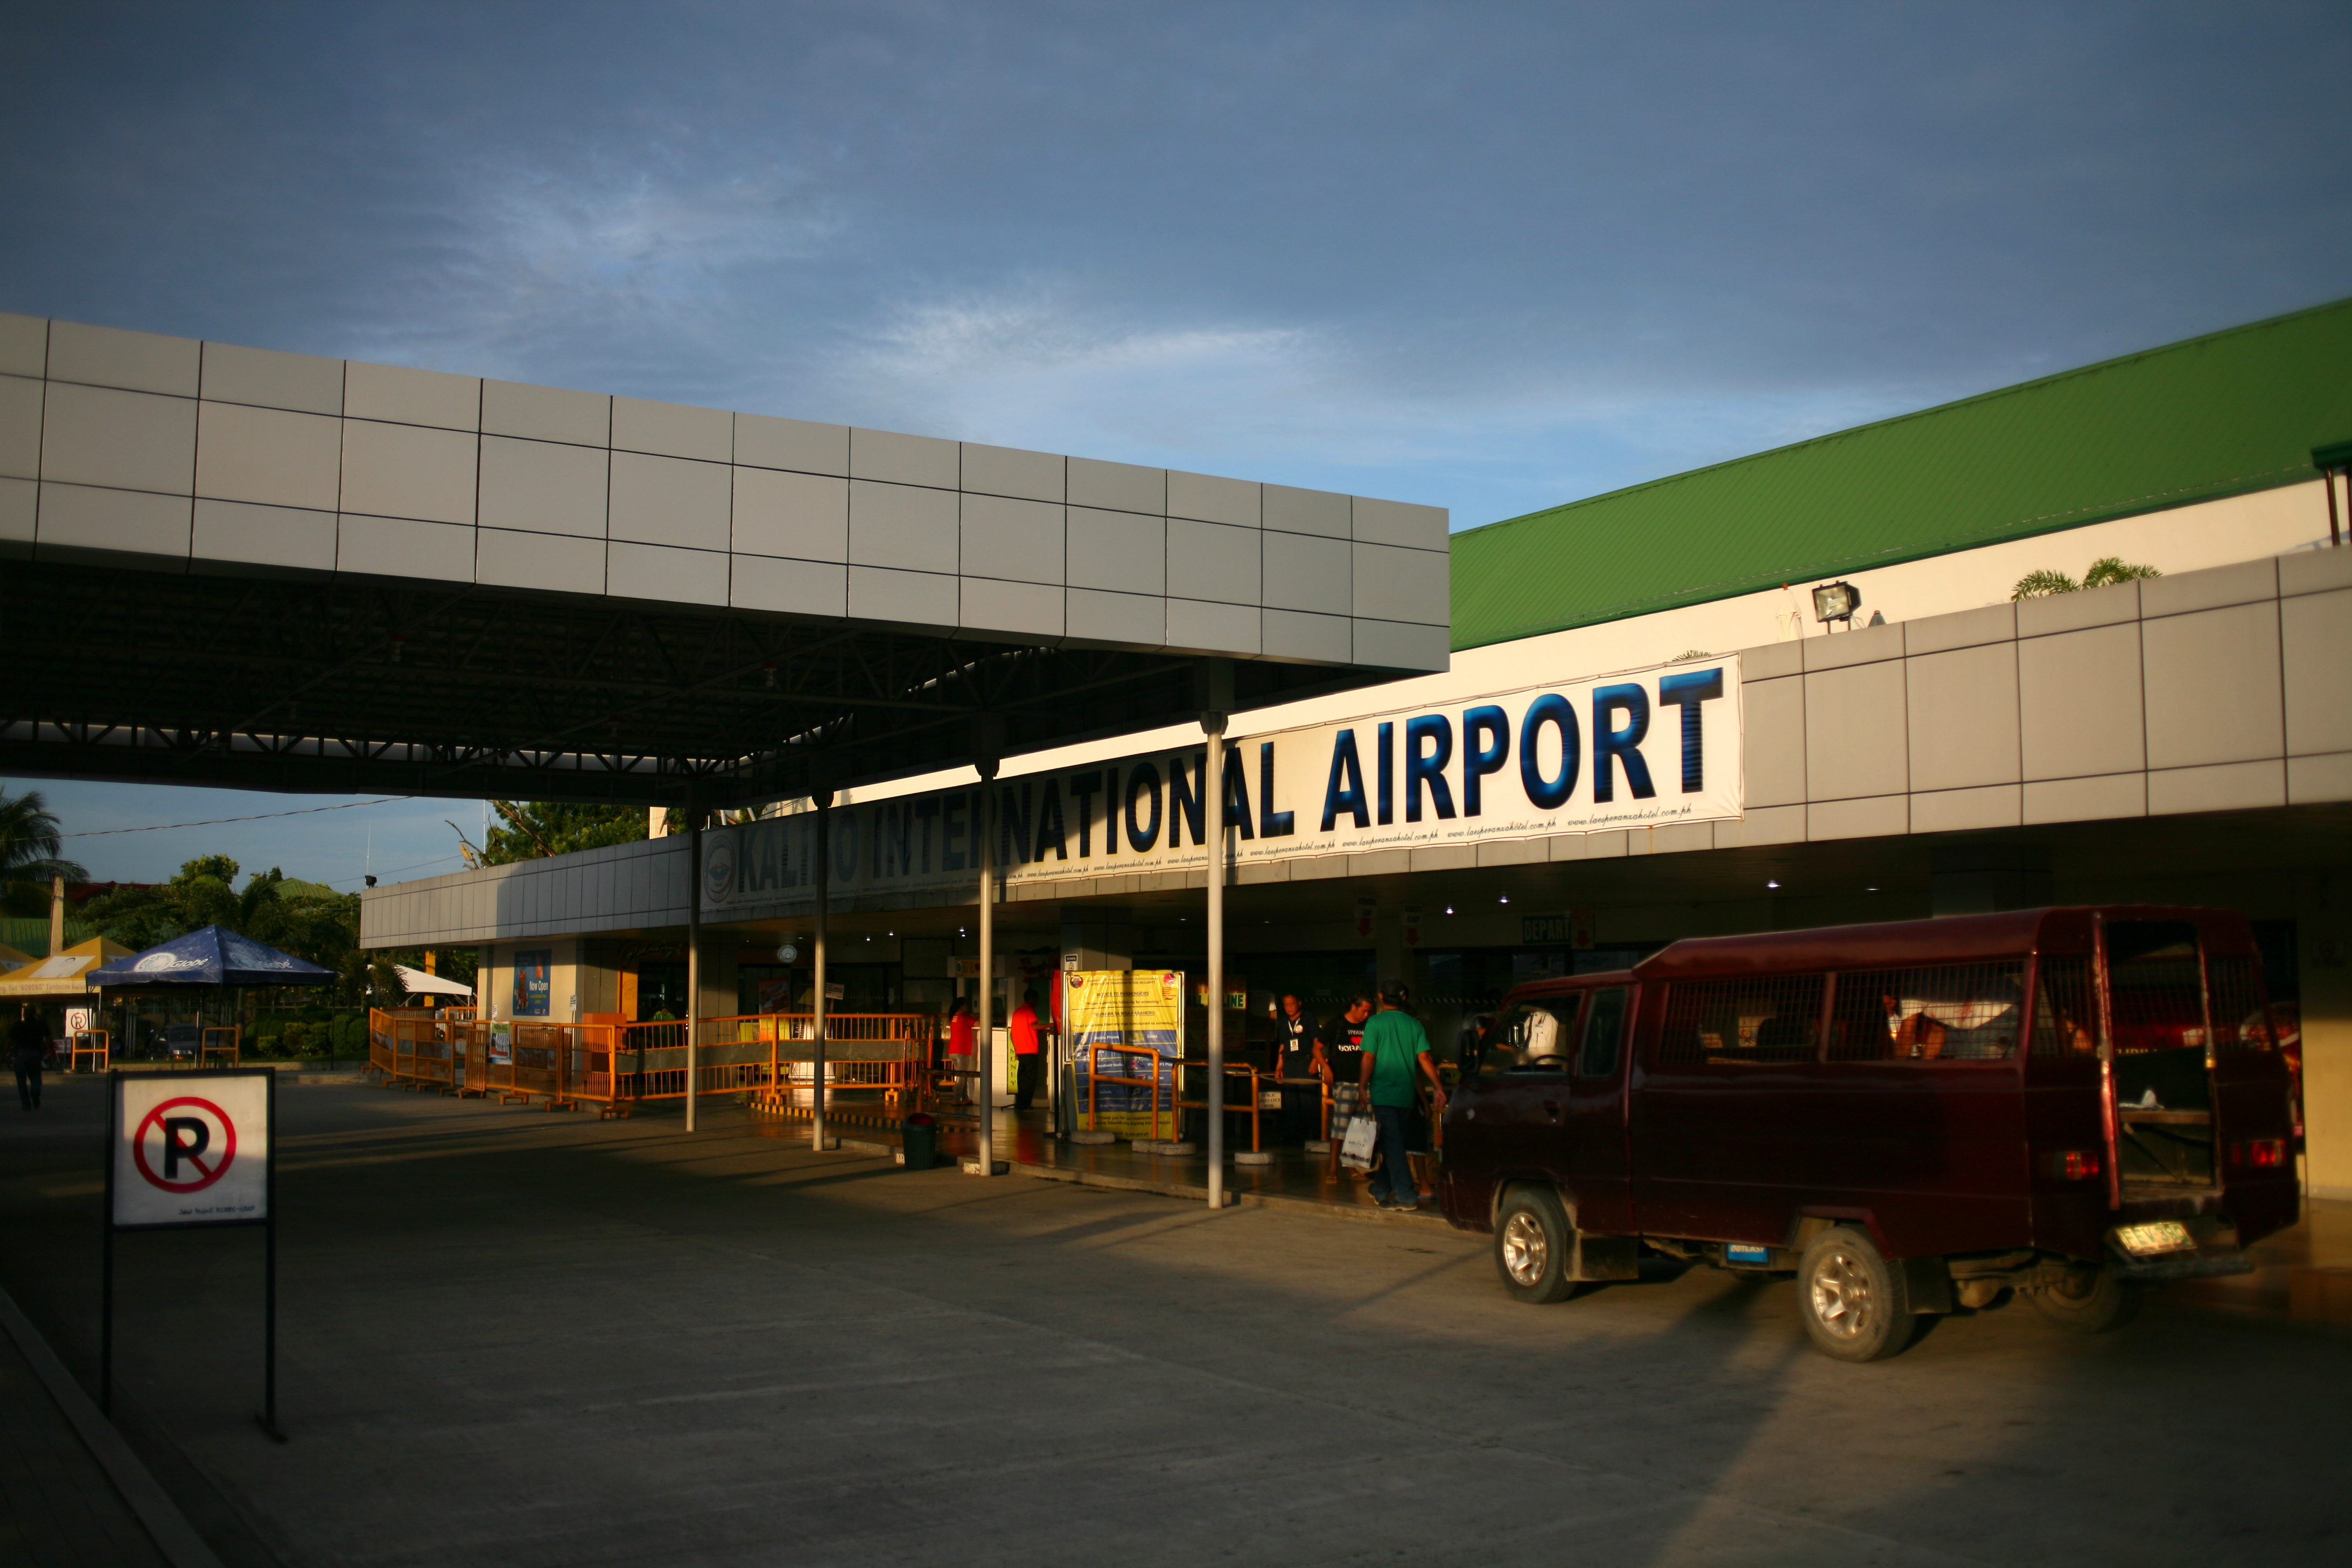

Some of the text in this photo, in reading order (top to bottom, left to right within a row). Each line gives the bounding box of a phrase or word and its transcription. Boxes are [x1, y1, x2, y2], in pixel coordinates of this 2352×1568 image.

[1320, 667, 1723, 832] AIRPORT
[1568, 803, 1691, 827] www.laesperanzahotel.com.ph
[171, 958, 207, 969] Globe
[529, 981, 548, 993] Now Open
